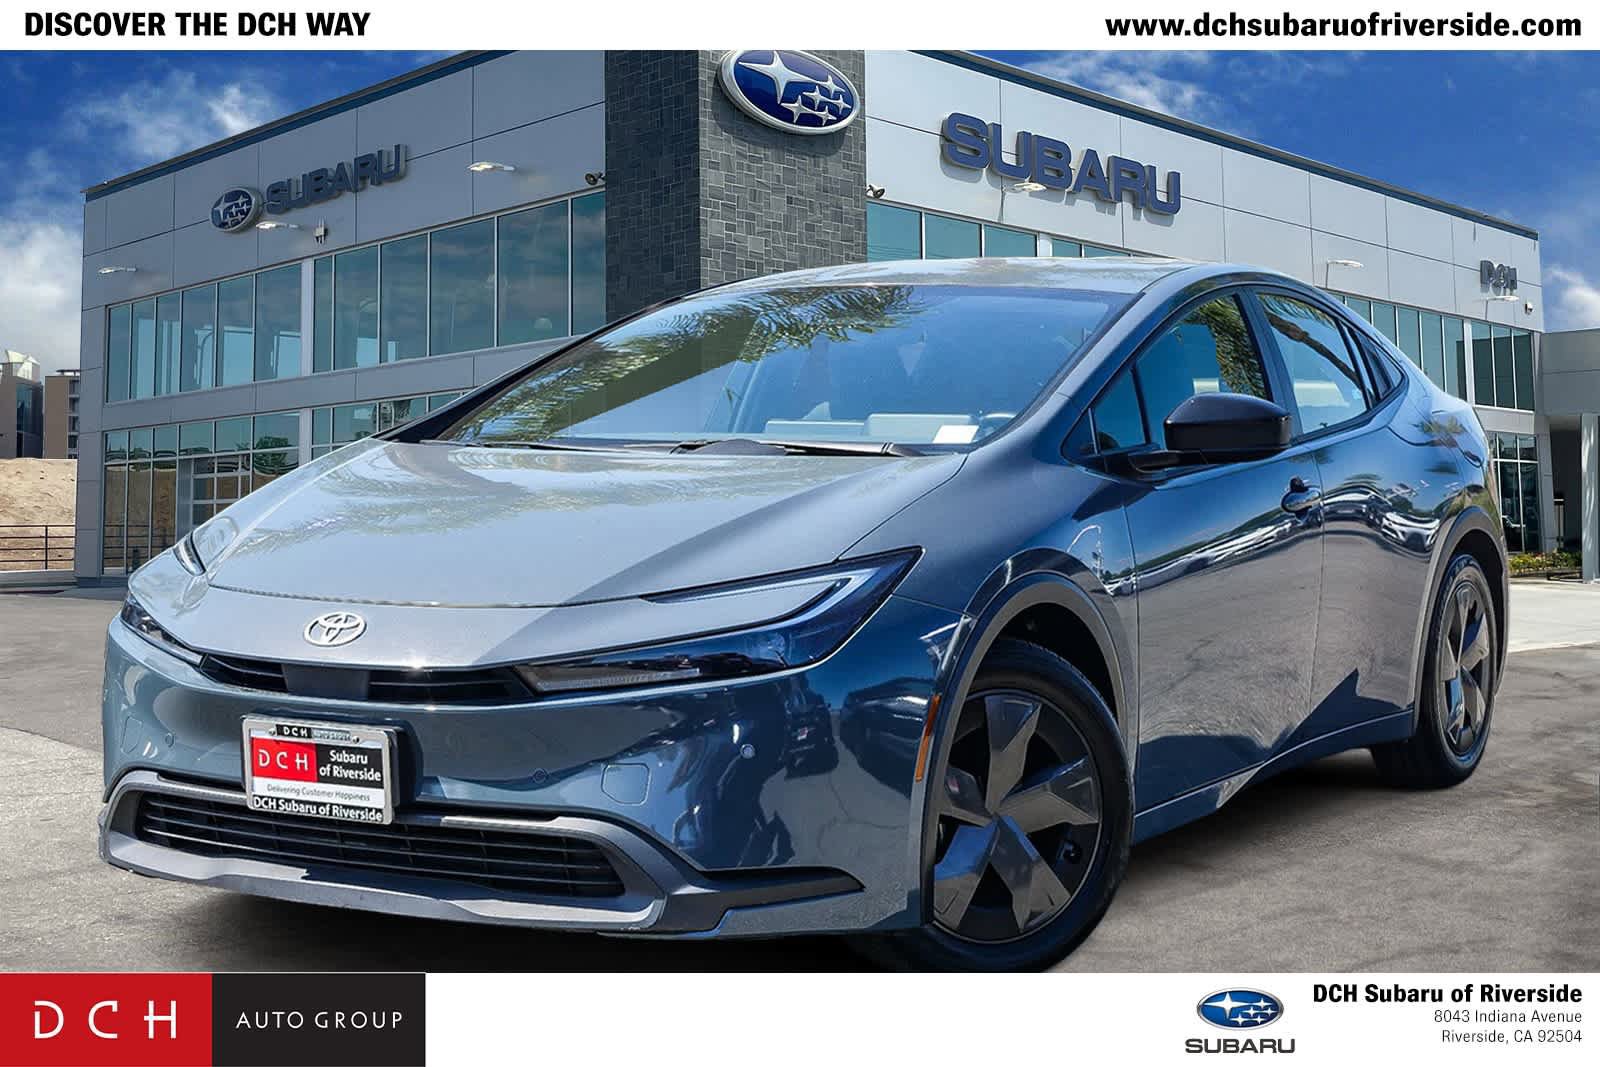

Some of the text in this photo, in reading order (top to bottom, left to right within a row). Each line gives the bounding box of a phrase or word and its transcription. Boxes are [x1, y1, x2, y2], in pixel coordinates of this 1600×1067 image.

[941, 112, 1181, 215] SUBARU
[266, 143, 406, 215] SUBARU
[283, 726, 308, 737] DCH
[258, 748, 309, 771] DCH
[329, 750, 368, 765] Subaru
[319, 764, 382, 781] of Riverside
[267, 783, 370, 802] Delivering Customer Happiness
[253, 797, 383, 822] DCH Subaru of Riverside
